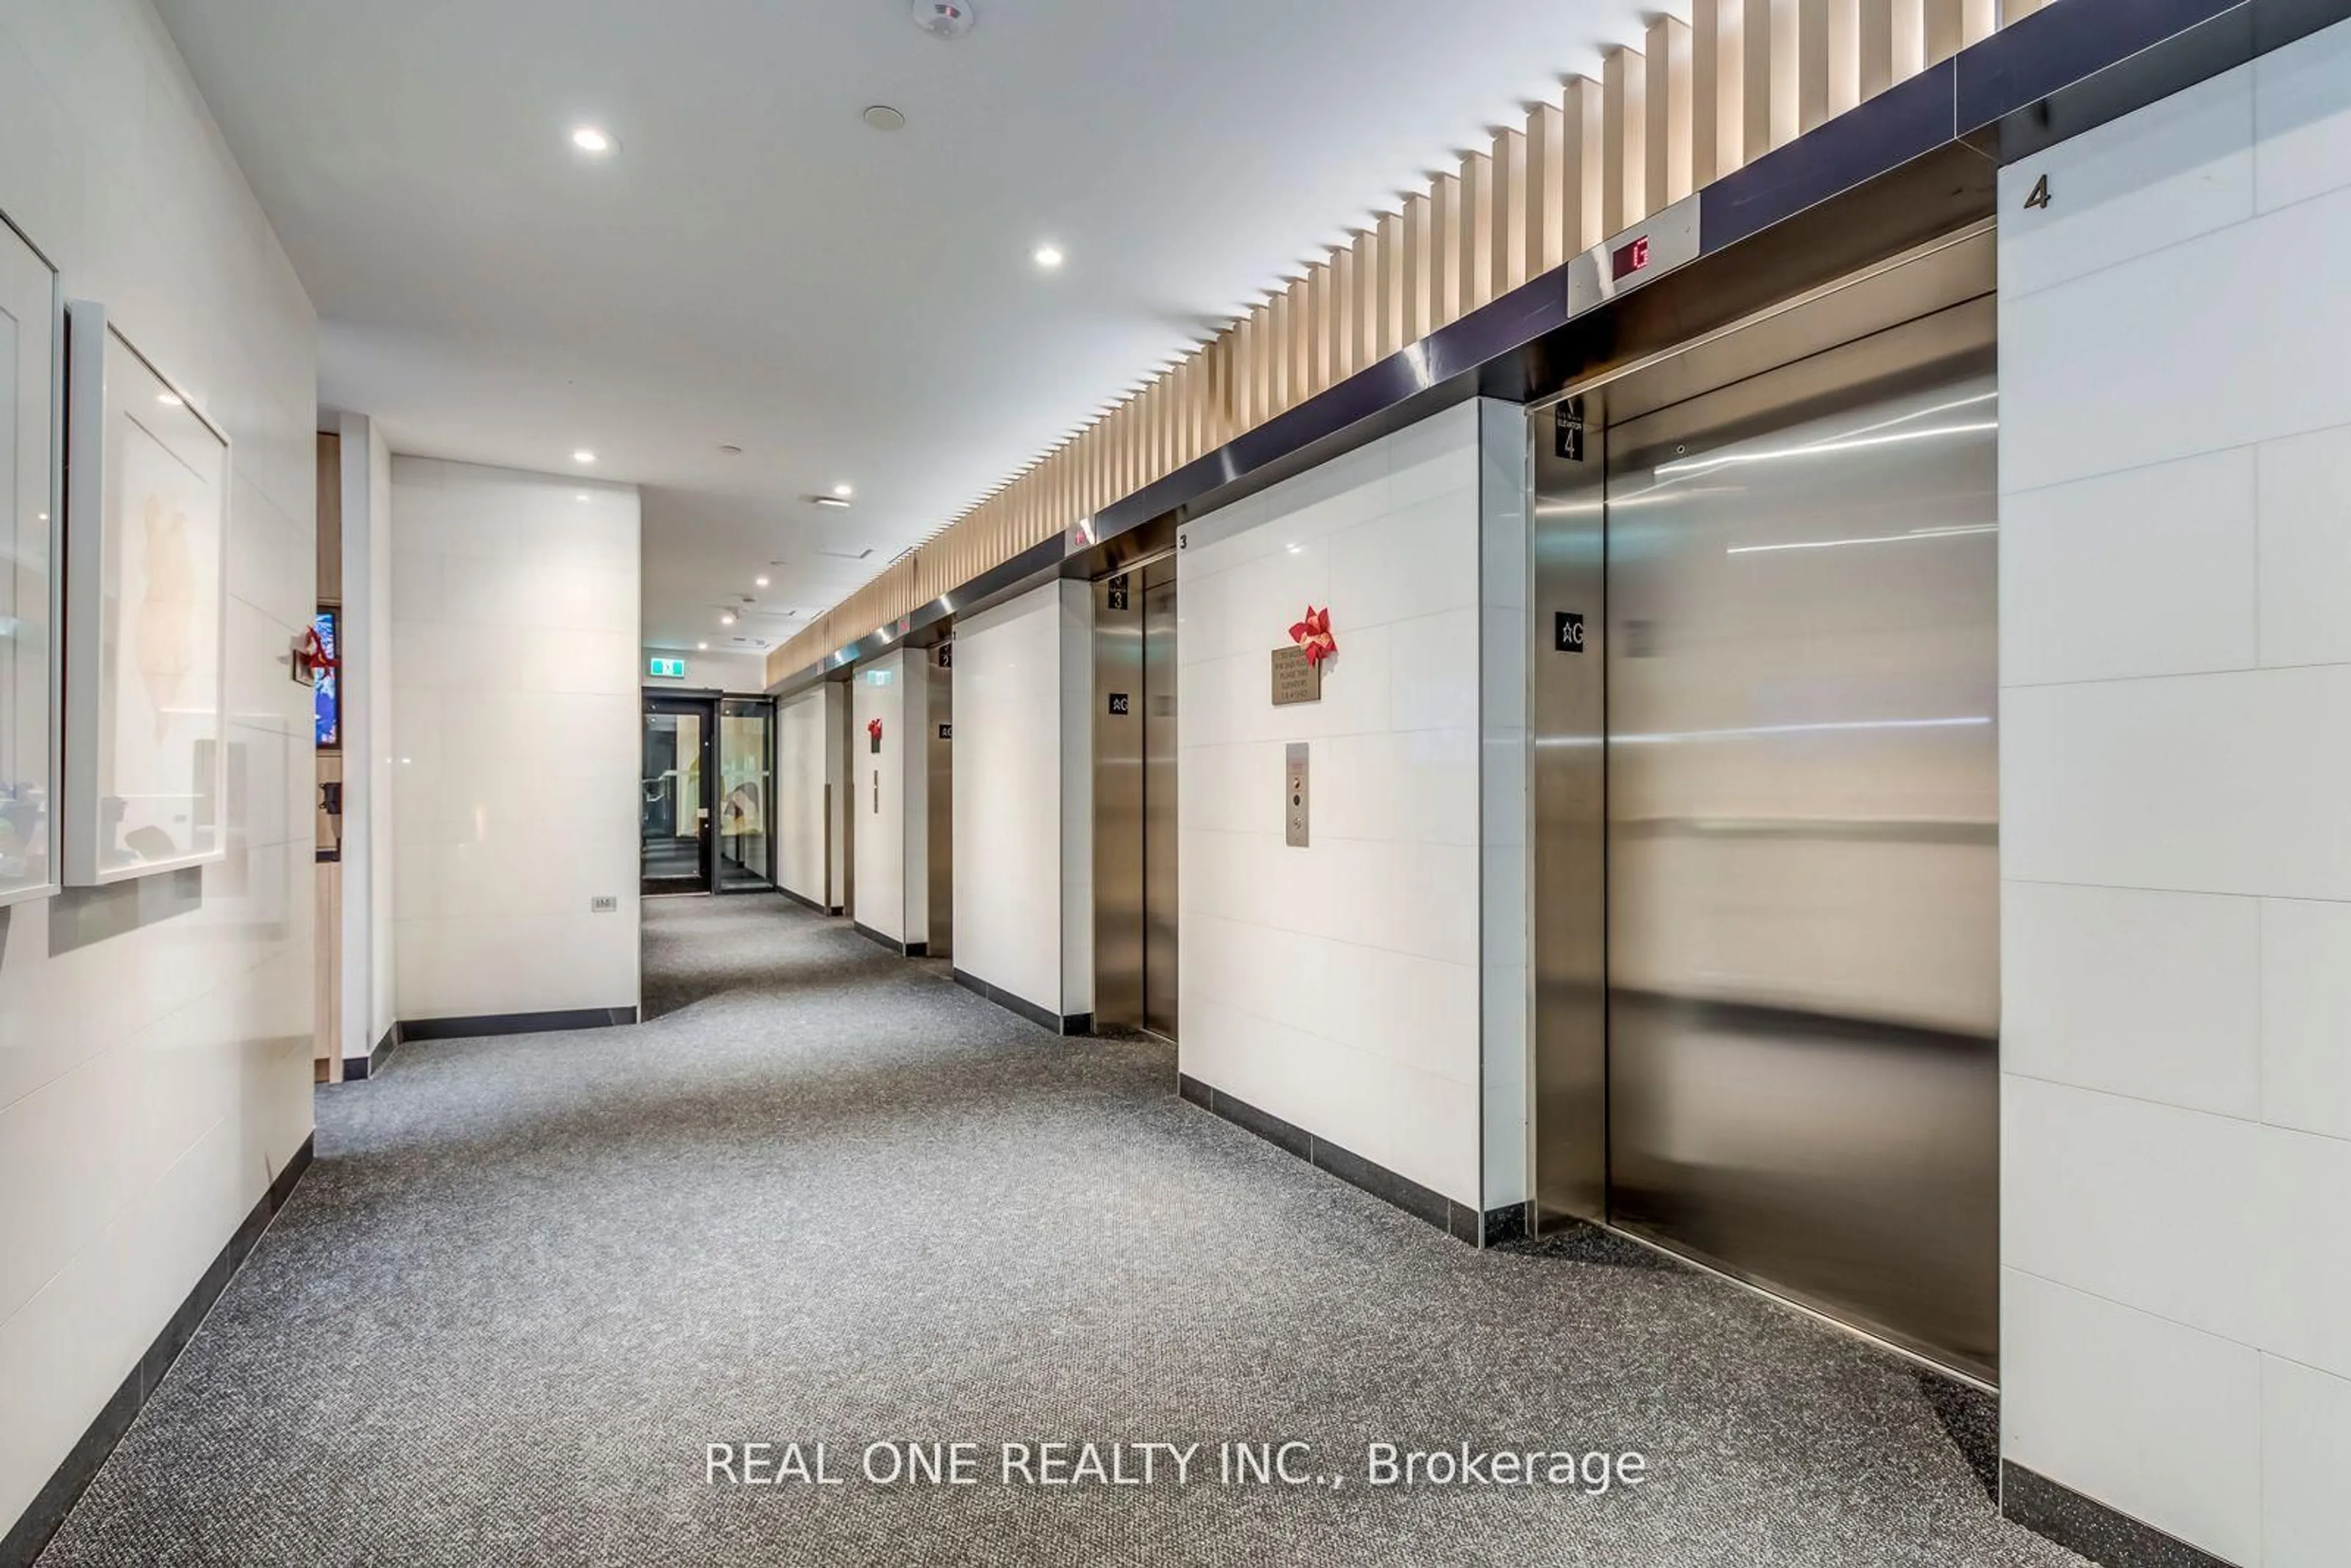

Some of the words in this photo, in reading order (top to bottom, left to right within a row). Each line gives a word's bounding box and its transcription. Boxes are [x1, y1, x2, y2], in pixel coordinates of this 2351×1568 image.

[2023, 174, 2052, 209] 4
[1633, 237, 1648, 268] G
[1565, 429, 1575, 459] 4
[1180, 533, 1187, 549] 3
[1115, 592, 1122, 608] 3
